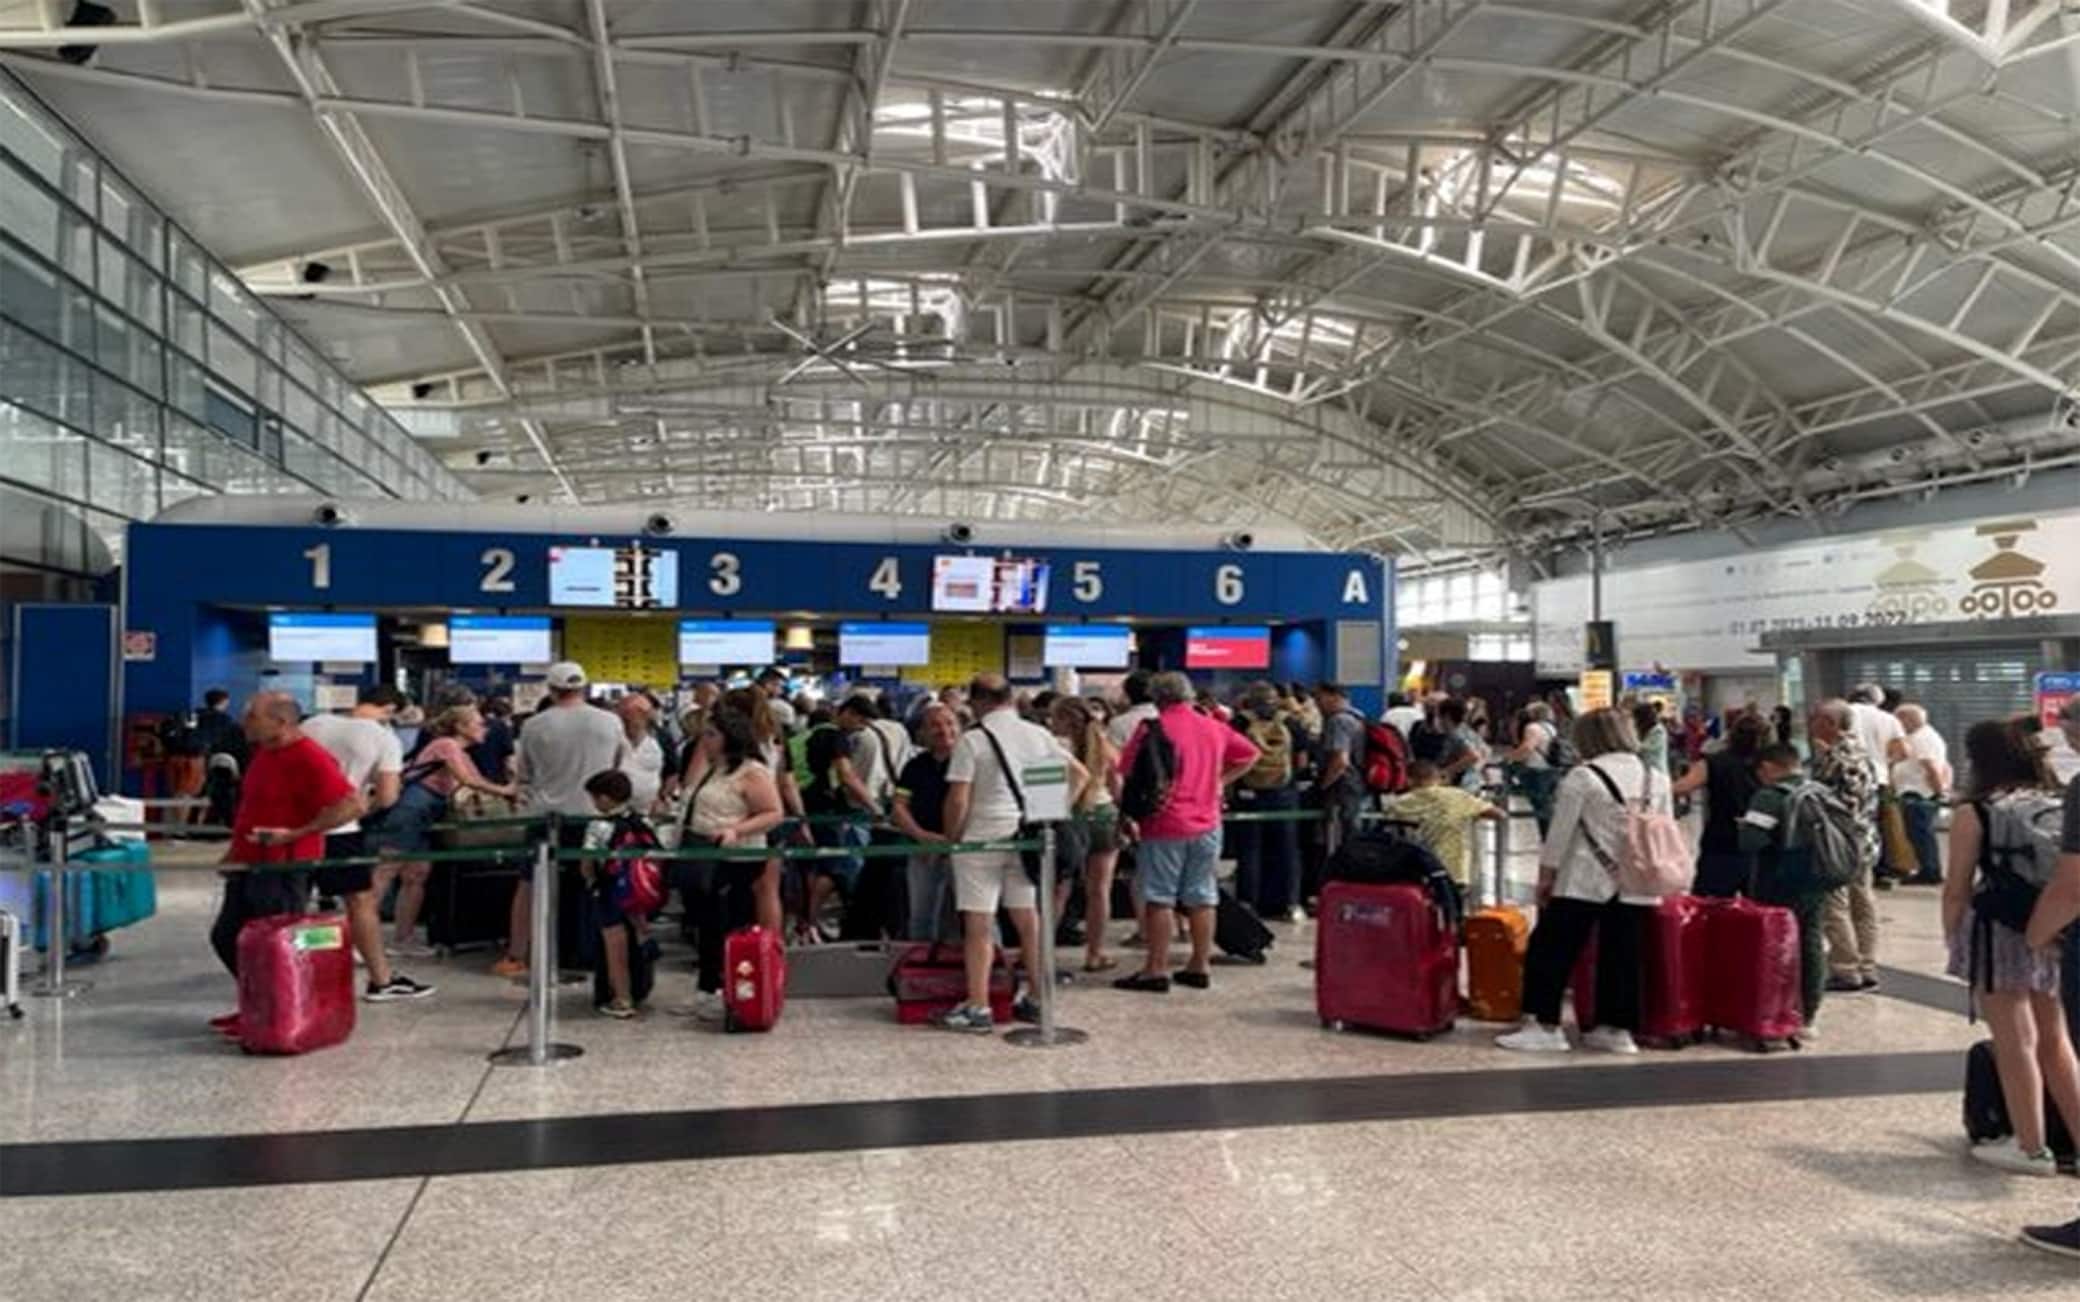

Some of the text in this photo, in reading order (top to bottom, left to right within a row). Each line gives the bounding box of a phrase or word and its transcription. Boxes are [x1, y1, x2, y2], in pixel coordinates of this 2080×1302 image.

[306, 546, 330, 588] 1
[480, 550, 516, 592] 2
[709, 553, 740, 595] 3
[869, 559, 902, 599] 4
[1073, 562, 1102, 602] 5
[1215, 566, 1243, 604] 6
[1342, 570, 1369, 605] A
